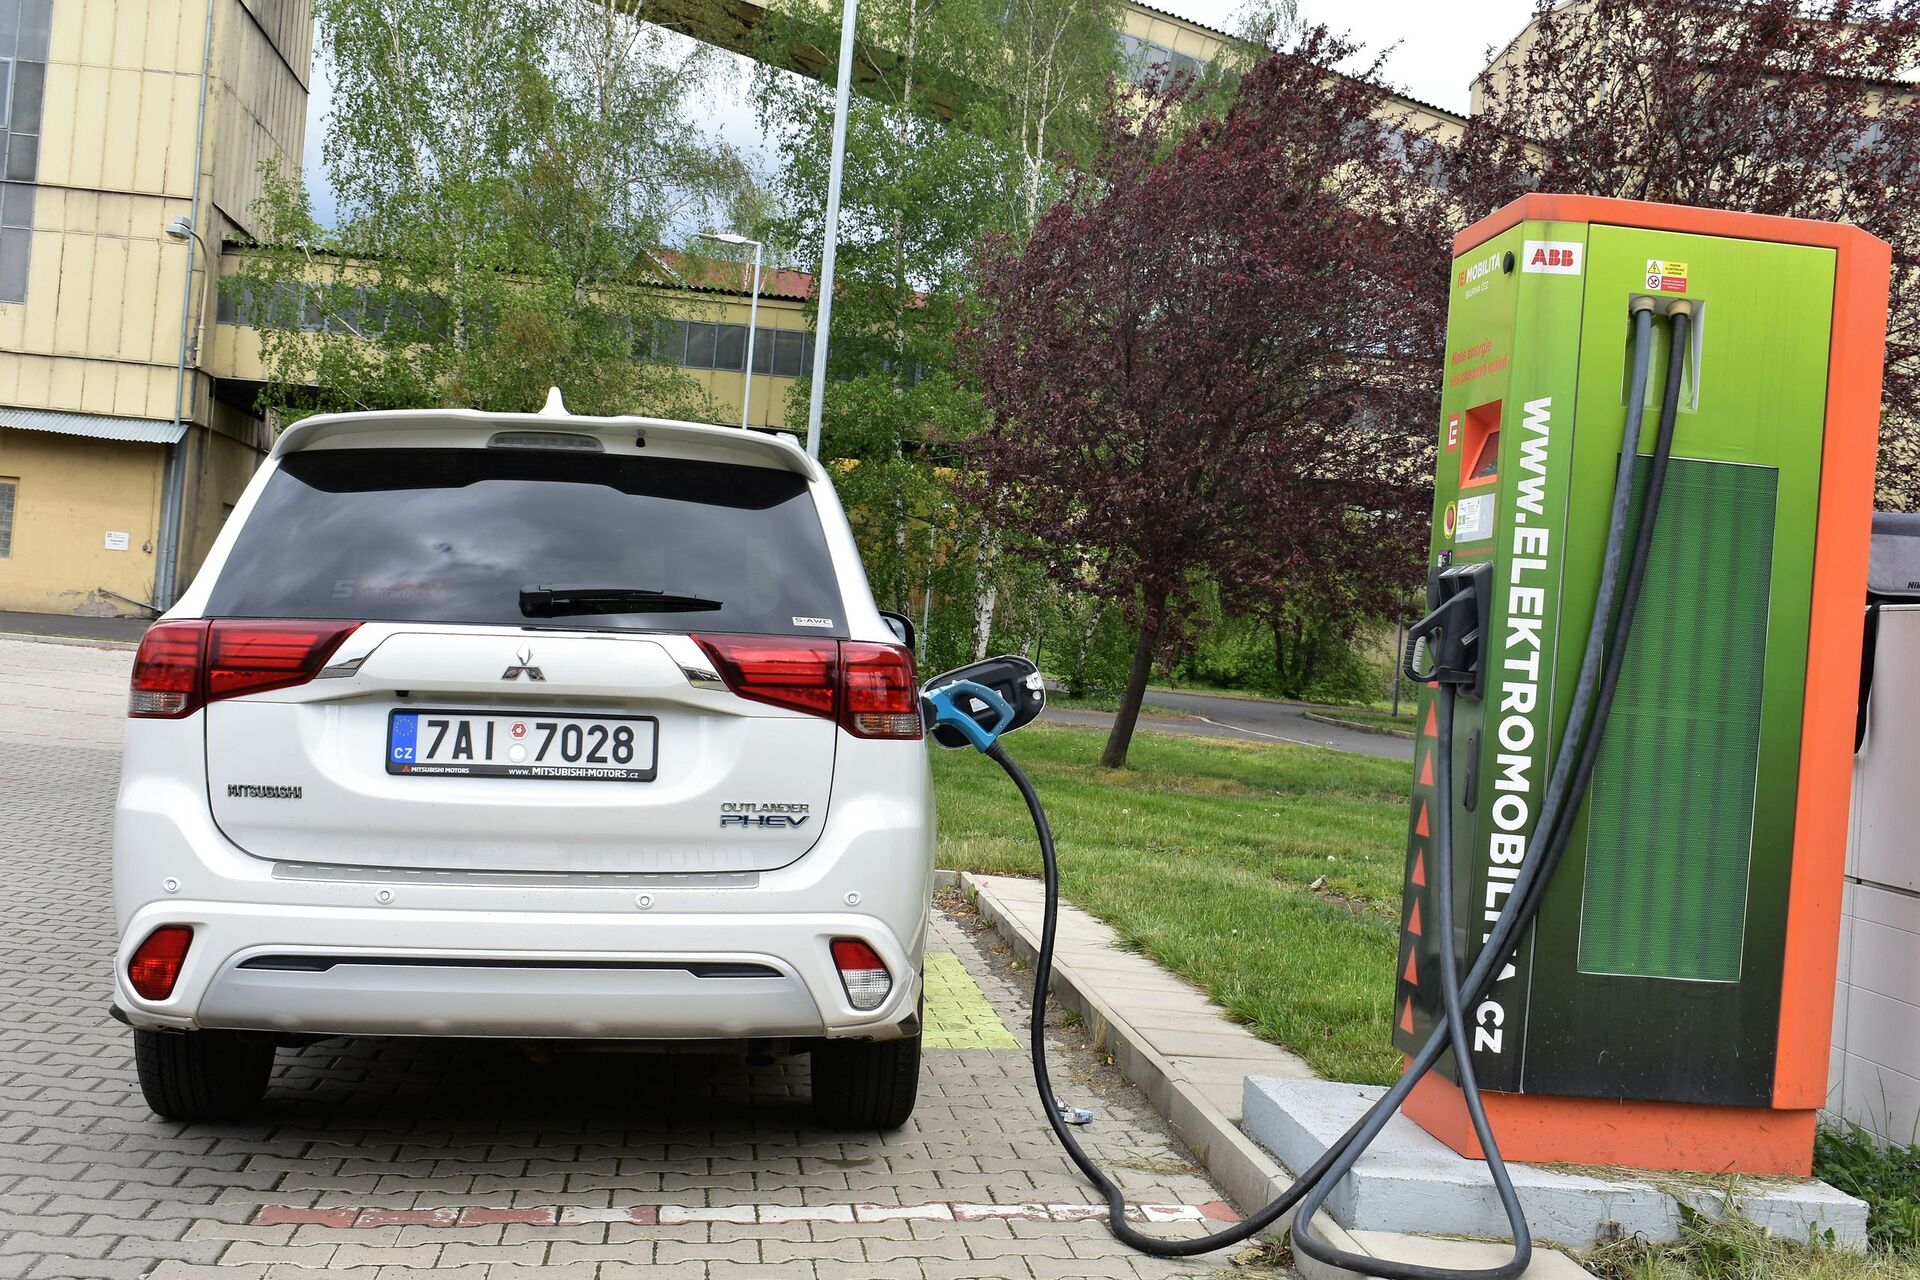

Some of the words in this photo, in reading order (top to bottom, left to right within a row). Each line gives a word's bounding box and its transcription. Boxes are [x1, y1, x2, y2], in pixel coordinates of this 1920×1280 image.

[1531, 248, 1574, 267] ABB
[795, 617, 831, 625] S-AWC
[534, 722, 635, 764] 7028
[394, 747, 412, 759] CZ
[227, 784, 303, 799] MITSUBISHI
[721, 802, 810, 813] OUTLANDER
[720, 814, 810, 828] PHEV
